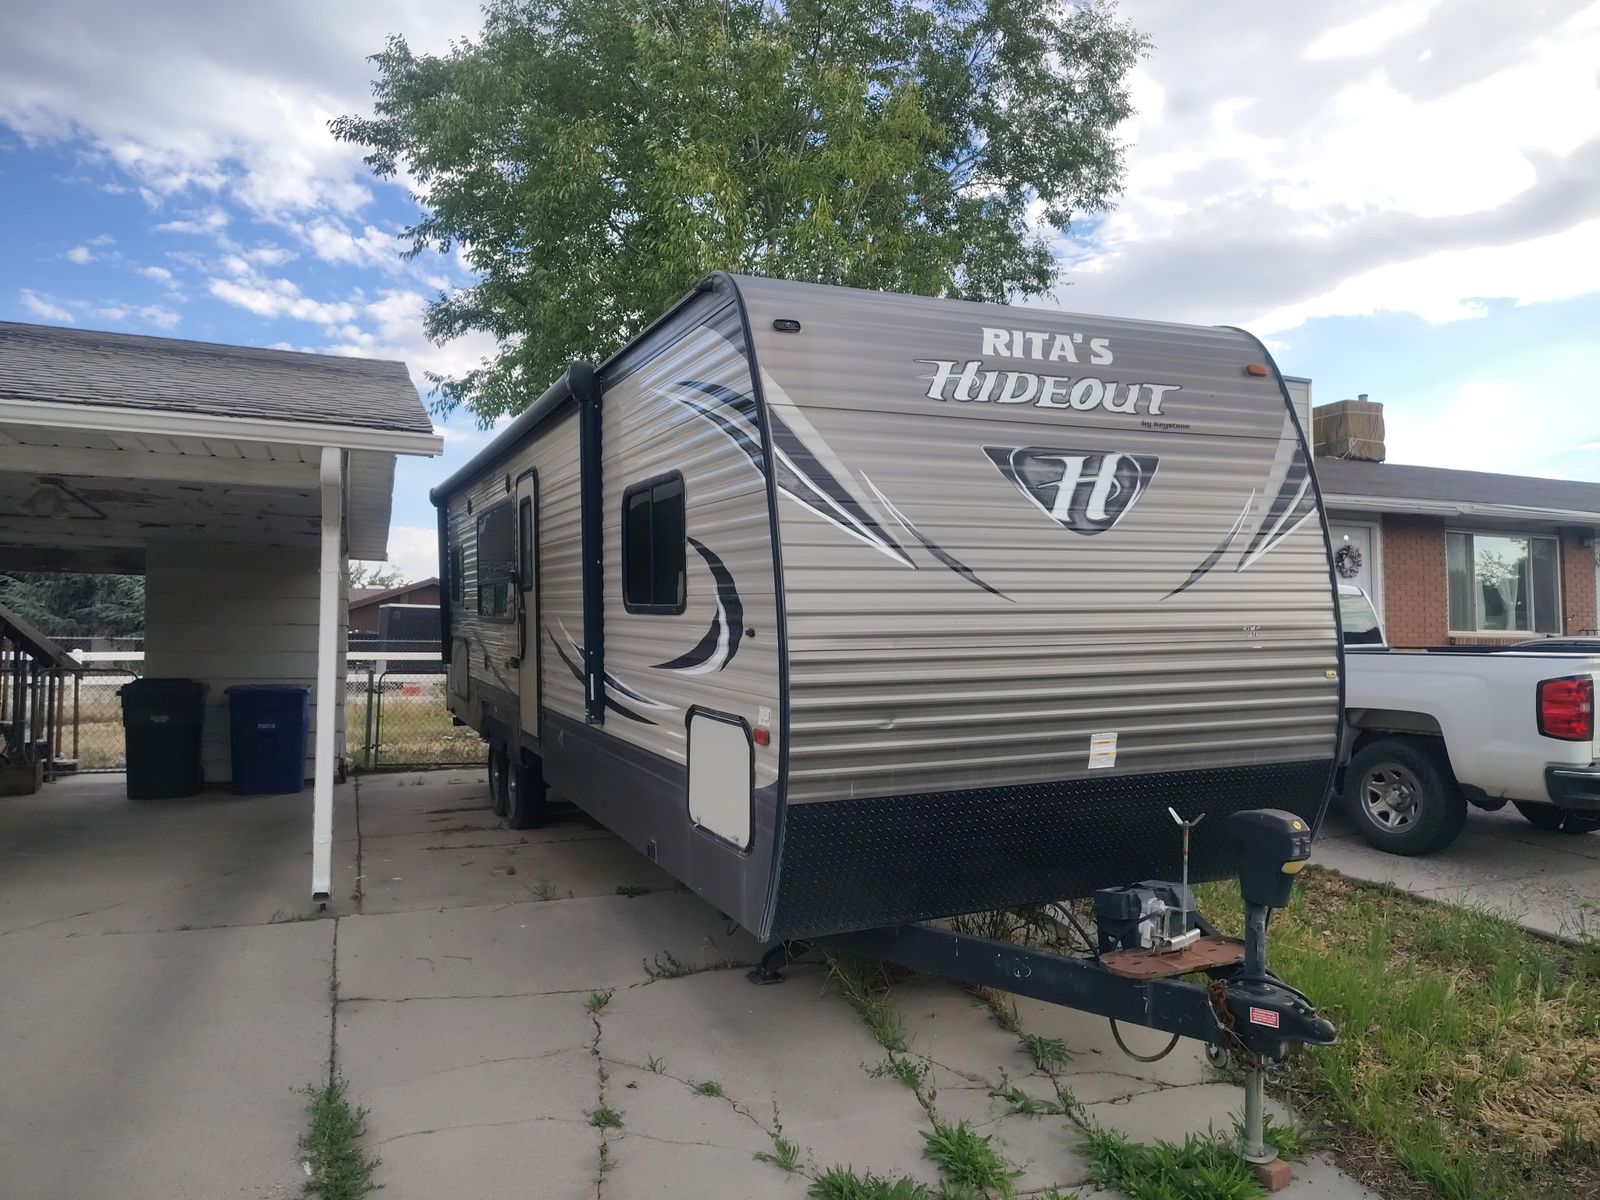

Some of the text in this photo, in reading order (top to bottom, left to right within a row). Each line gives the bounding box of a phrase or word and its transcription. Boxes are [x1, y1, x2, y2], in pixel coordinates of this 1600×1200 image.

[981, 327, 1114, 366] RITA'S
[913, 358, 1182, 416] HIDEOUT
[1141, 420, 1191, 430] by Keystone
